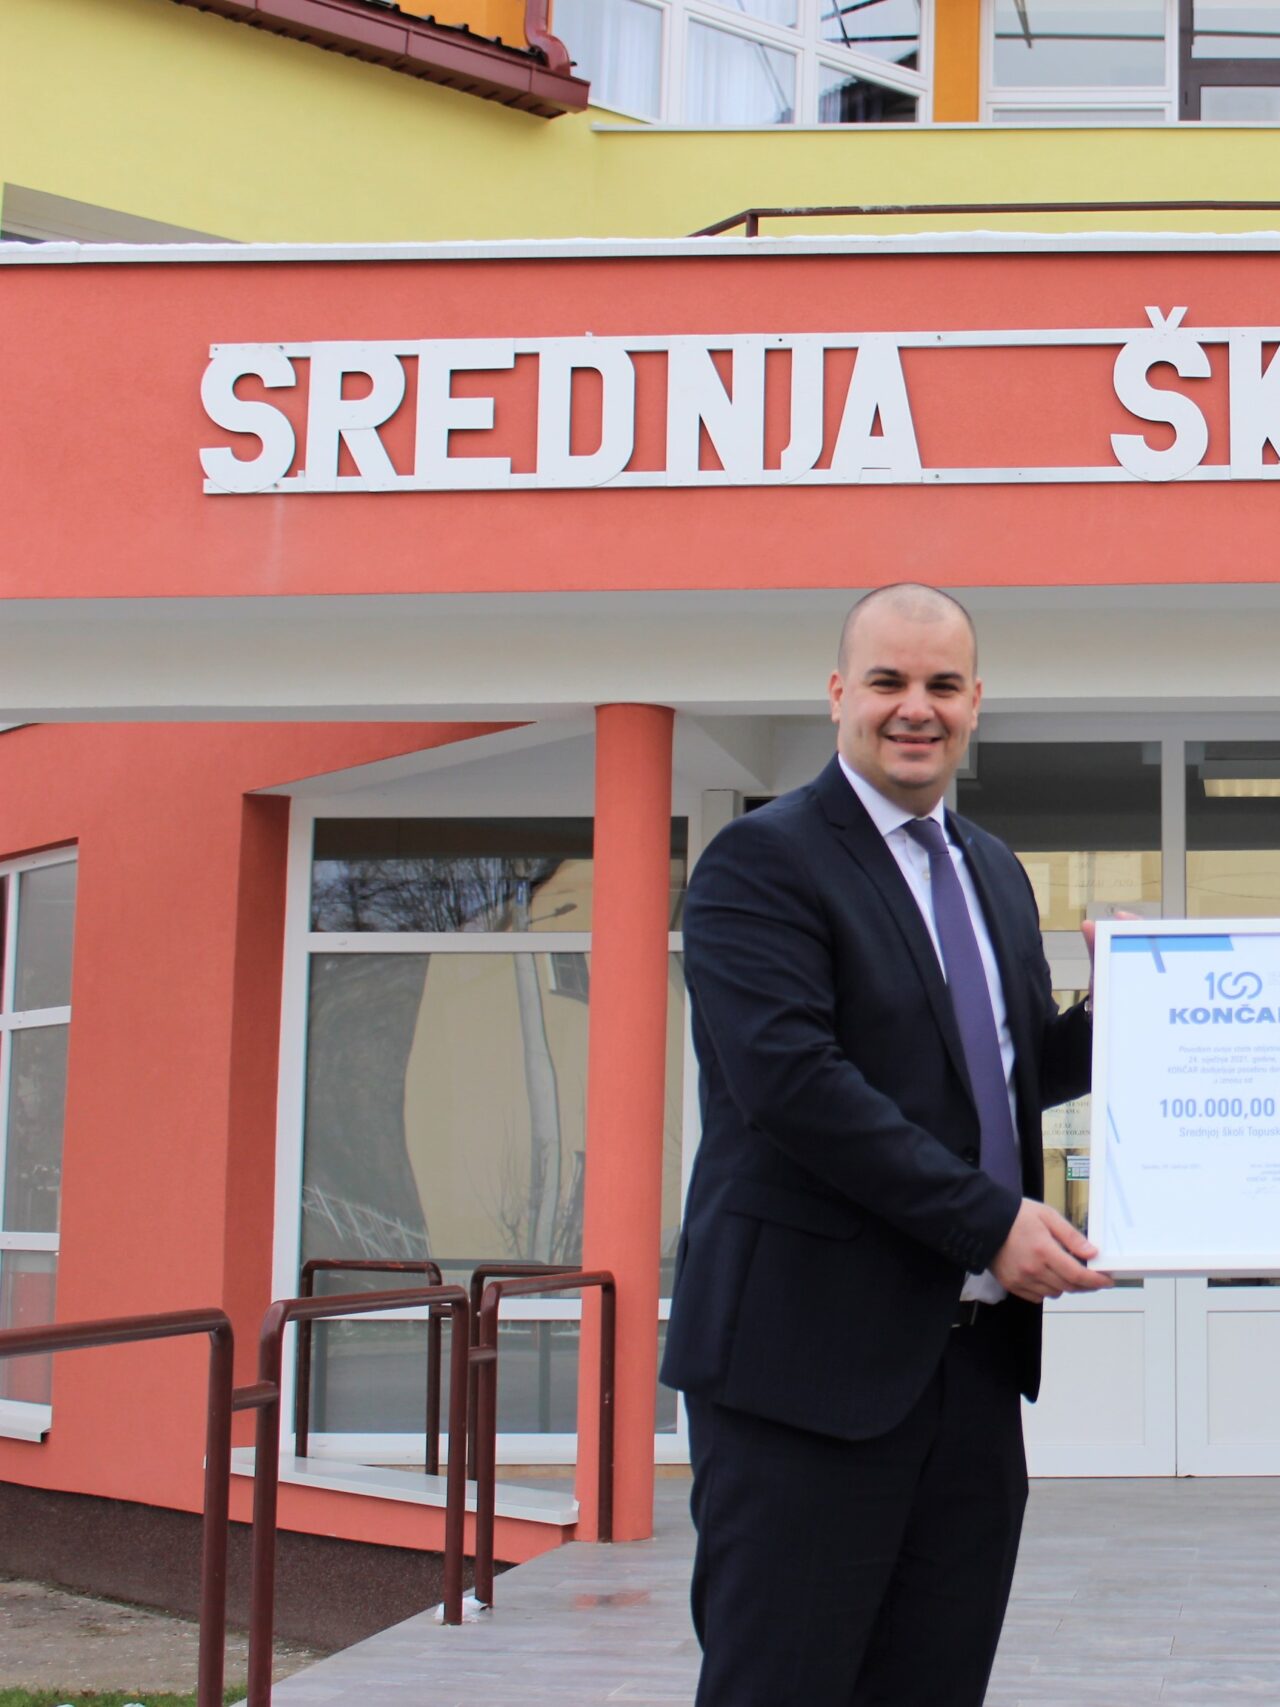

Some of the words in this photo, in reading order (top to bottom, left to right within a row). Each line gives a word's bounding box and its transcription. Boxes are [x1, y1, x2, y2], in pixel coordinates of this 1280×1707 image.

[199, 332, 925, 494] SREDNJA
[1160, 1098, 1275, 1118] 100.000,00
[1179, 1127, 1219, 1138] Srednjoj
